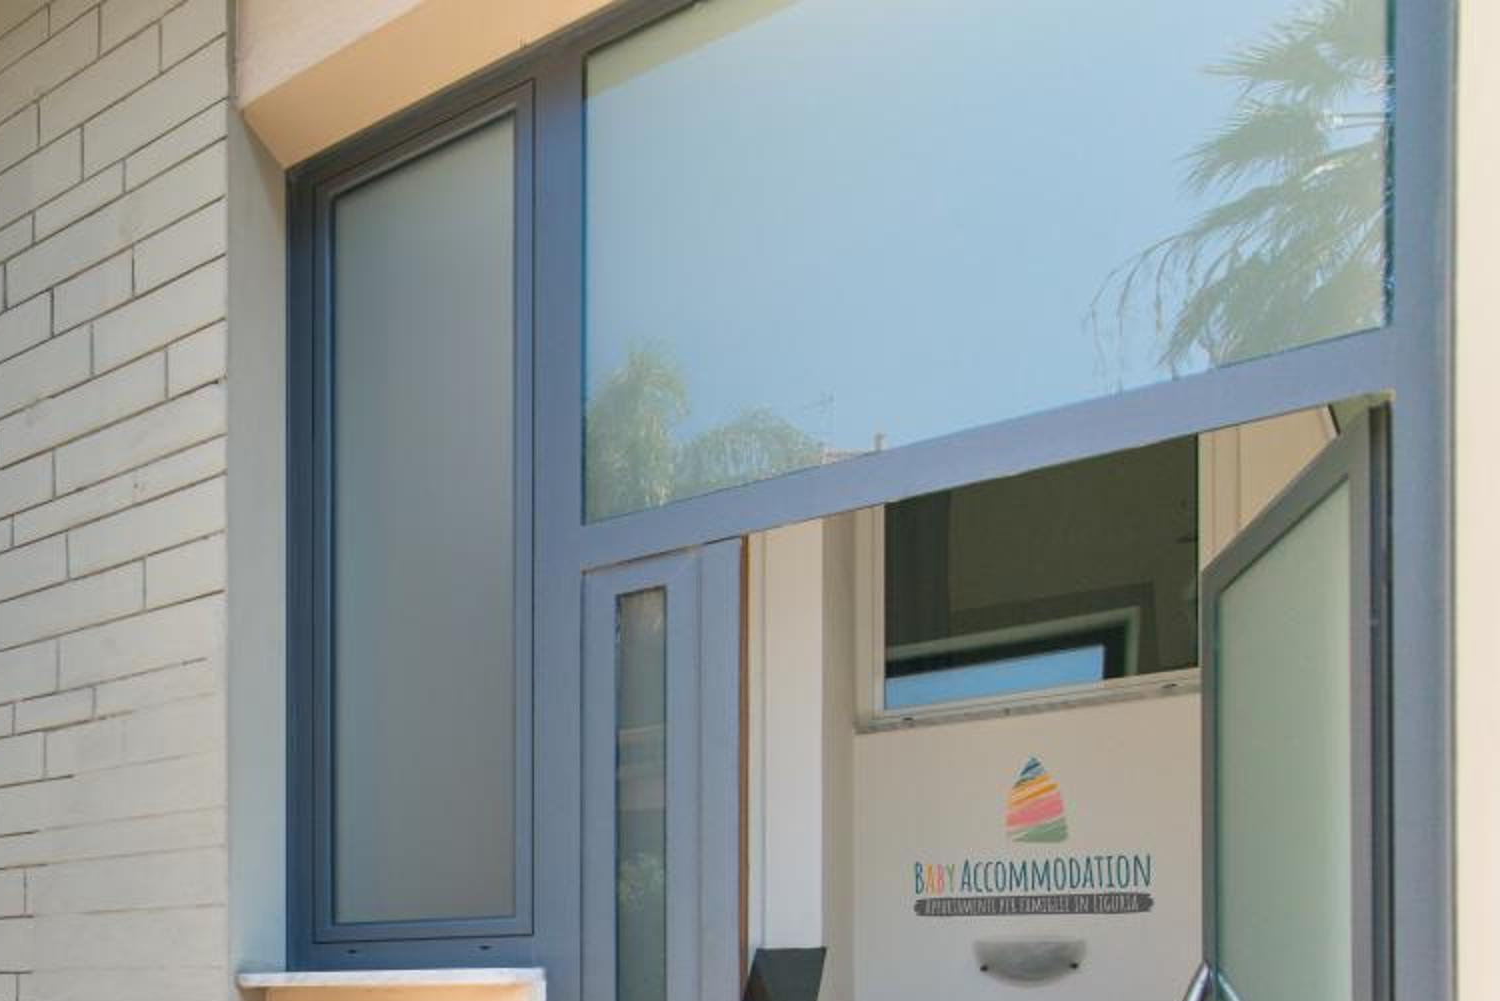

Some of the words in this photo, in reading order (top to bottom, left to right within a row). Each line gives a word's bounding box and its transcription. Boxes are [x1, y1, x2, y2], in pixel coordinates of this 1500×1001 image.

[914, 861, 956, 895] BABY
[961, 854, 1152, 893] ACCOMMODATION
[1092, 893, 1140, 913] LIGURIA
